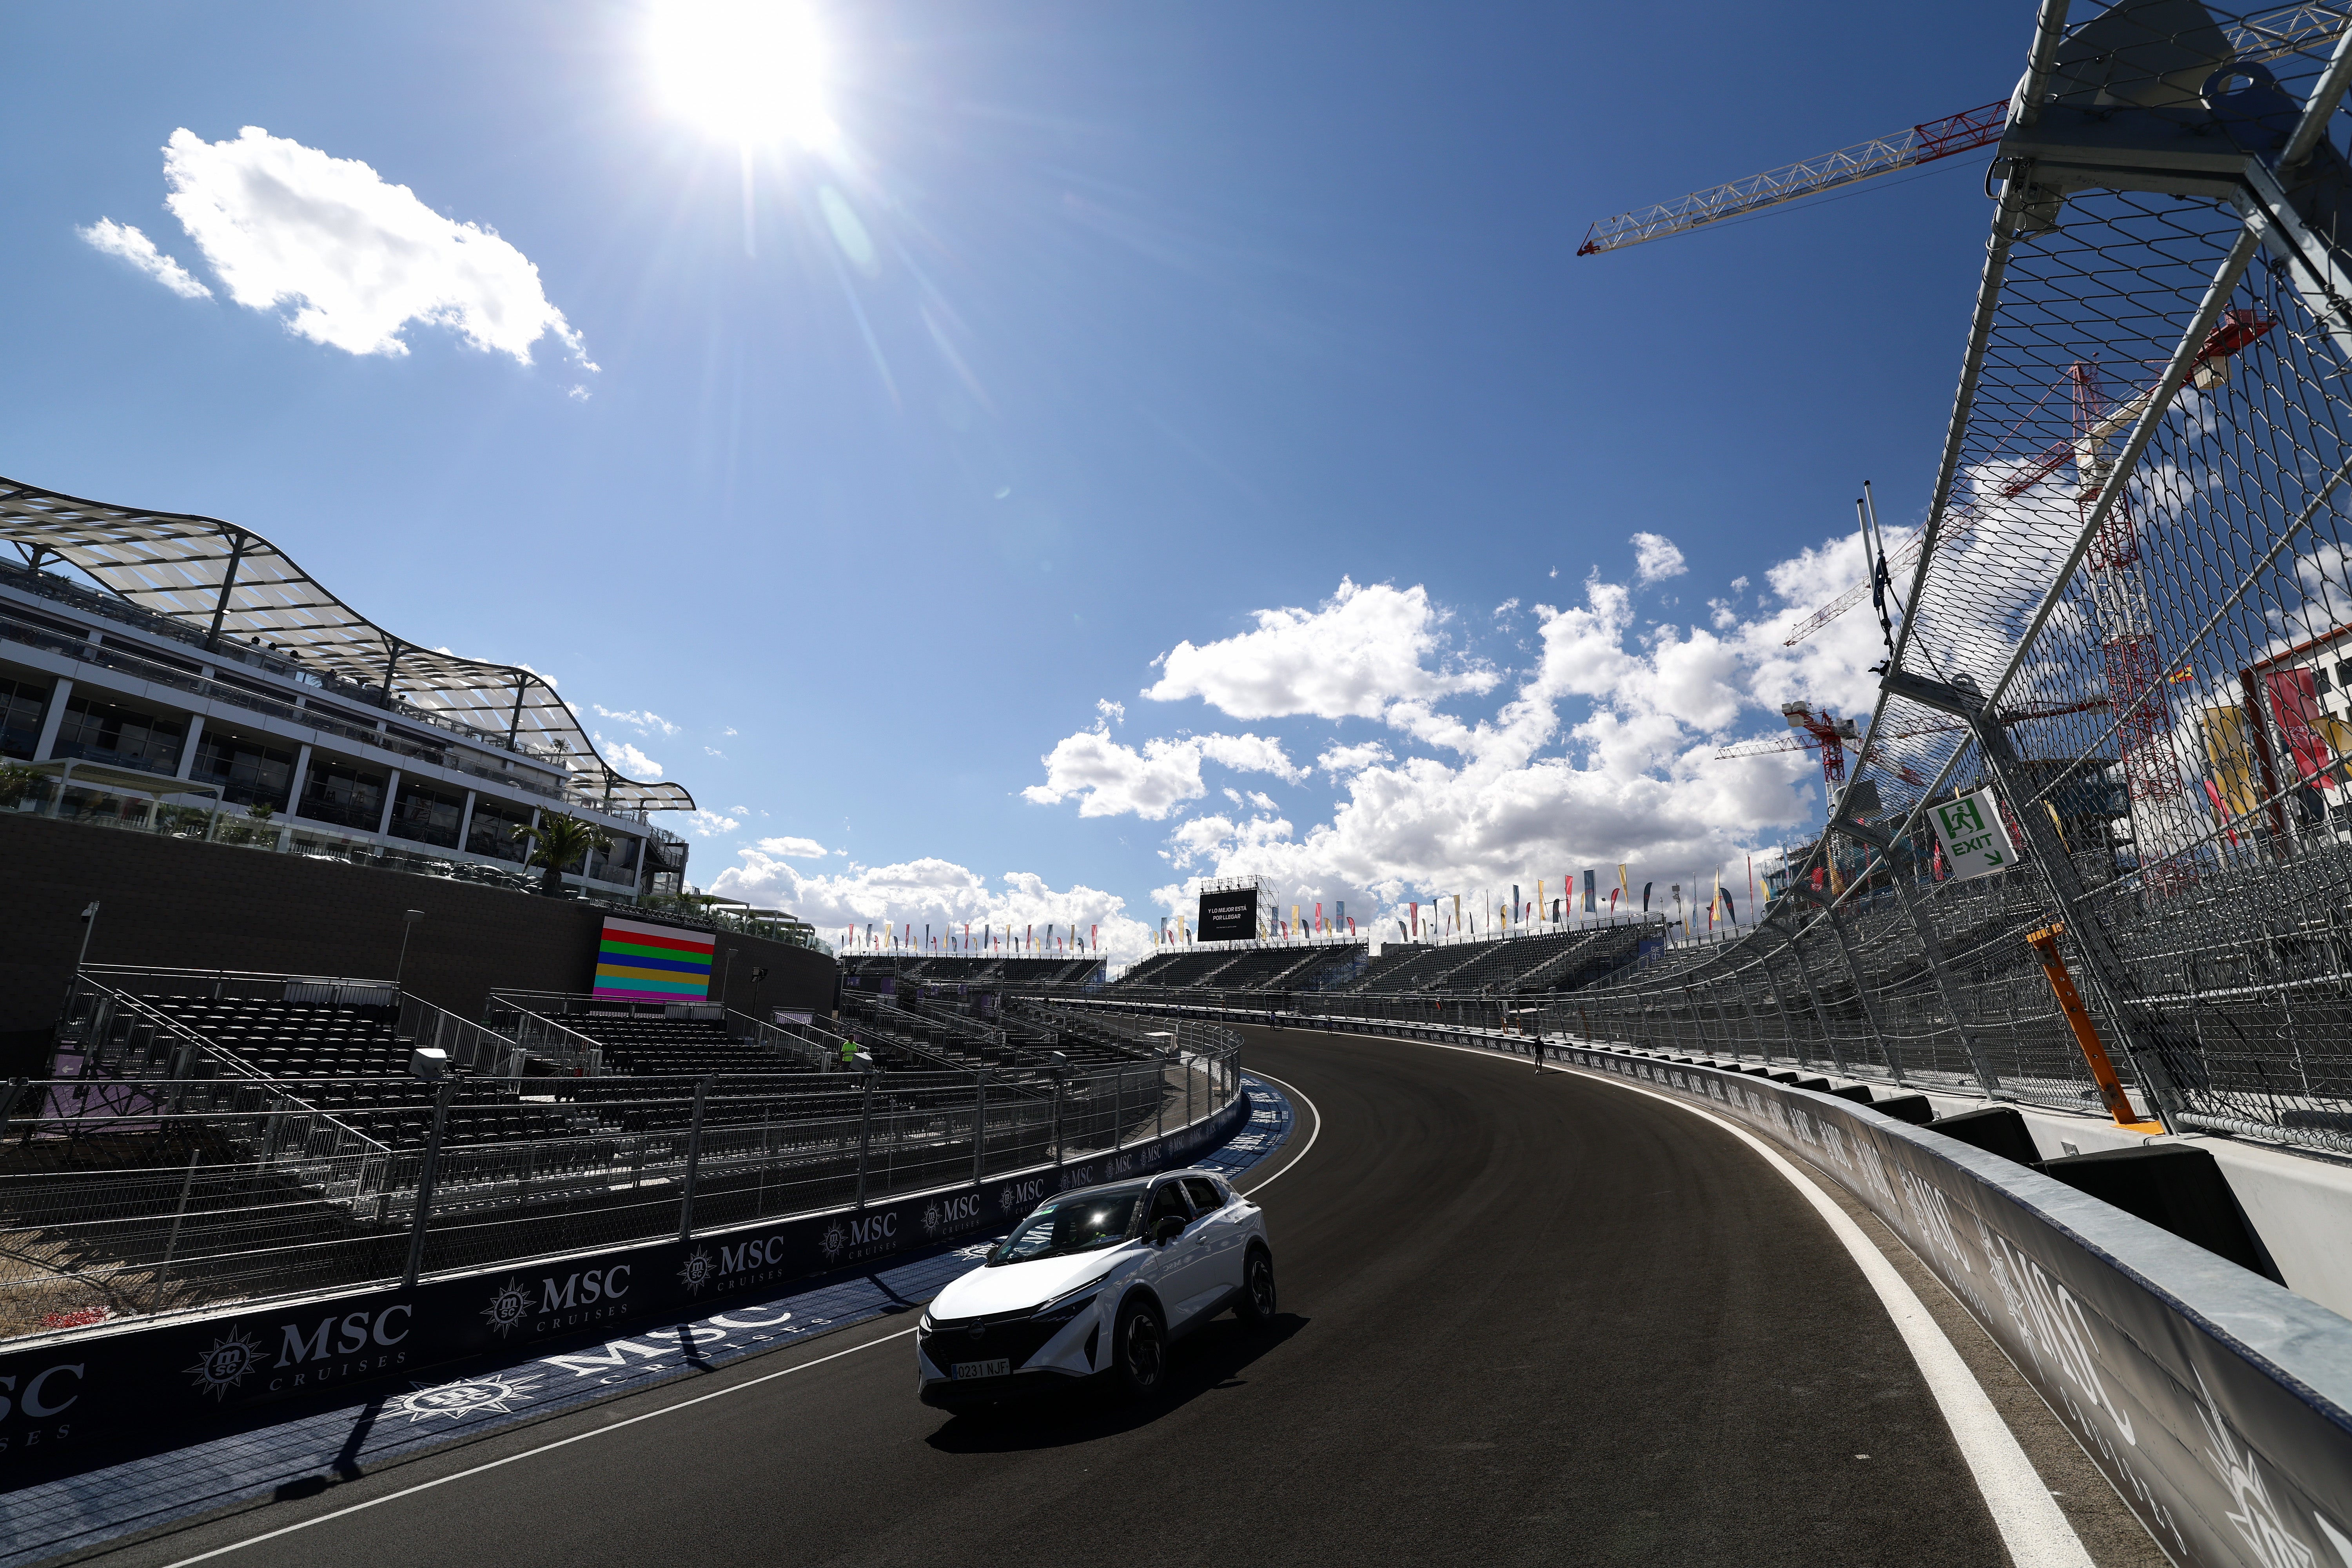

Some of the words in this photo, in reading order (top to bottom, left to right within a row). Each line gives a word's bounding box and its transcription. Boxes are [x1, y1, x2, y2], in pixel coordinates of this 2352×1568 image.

[1951, 833, 1992, 857] EXIT
[1592, 1056, 1602, 1067] MSC
[1607, 1058, 1617, 1071] MSC
[1622, 1062, 1633, 1074] MSC
[1638, 1064, 1650, 1078] MSC
[1655, 1067, 1667, 1083] MSC
[1672, 1071, 1685, 1088] MSC
[1690, 1074, 1704, 1094] MSC
[1709, 1079, 1724, 1100] MSC
[1728, 1084, 1744, 1109] MSC
[1748, 1091, 1765, 1118] MSC
[1148, 1144, 1161, 1163] MSC
[1174, 1135, 1184, 1152] MSC
[1115, 1154, 1132, 1174] MSC
[1071, 1165, 1093, 1188] MSC
[1016, 1178, 1044, 1204] MSC
[943, 1194, 980, 1223] MSC
[1016, 1202, 1039, 1214] CRUIS
[850, 1212, 897, 1246] MSC
[943, 1219, 979, 1235] CRUISES
[1908, 1171, 1971, 1272] MSC
[719, 1236, 784, 1275] MSC
[849, 1241, 896, 1259] CRUISES
[539, 1265, 630, 1313] MSC
[718, 1269, 782, 1291] CRUISES
[537, 1304, 627, 1332] CRUISES
[273, 1304, 412, 1368] MSC
[523, 1307, 791, 1377] MSC
[1998, 1234, 2136, 1445] MSC
[269, 1352, 406, 1391] CRUISES
[958, 1364, 983, 1378] 0231
[987, 1361, 1006, 1375] NJF
[2060, 1386, 2187, 1556] CRUISES
